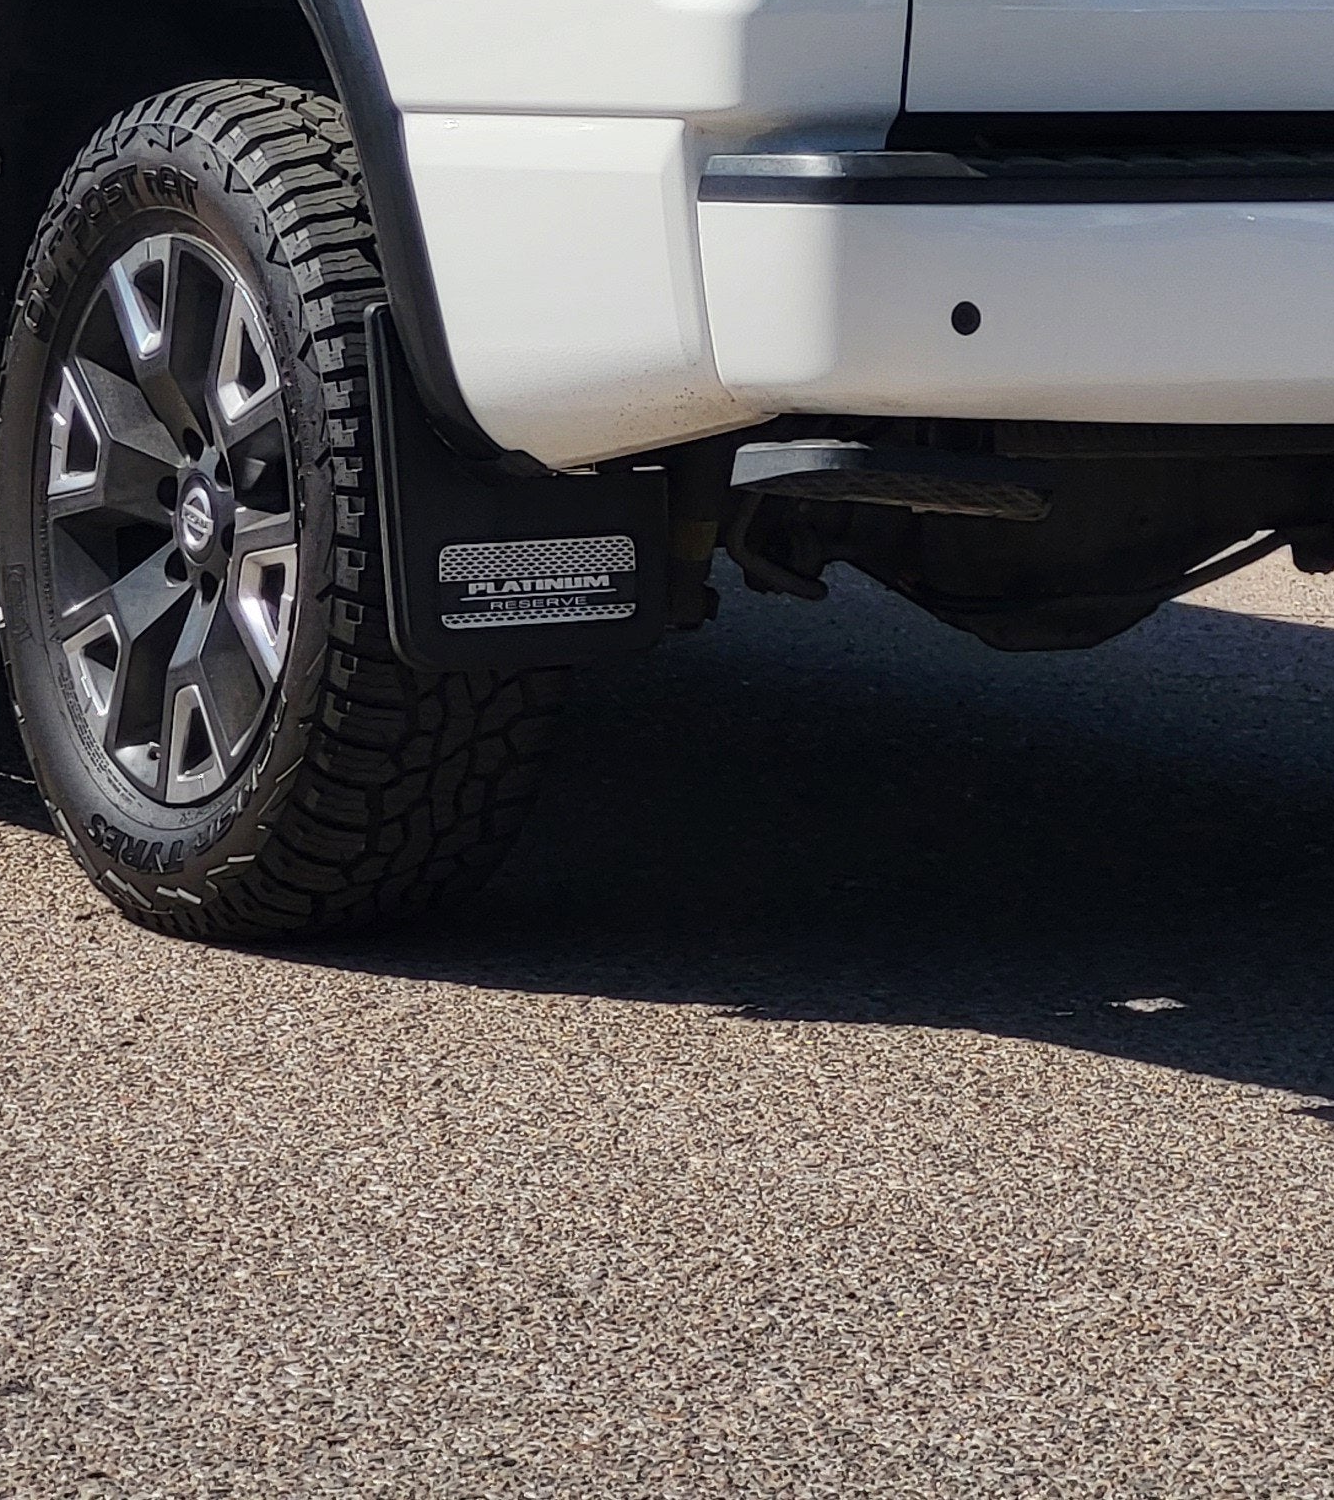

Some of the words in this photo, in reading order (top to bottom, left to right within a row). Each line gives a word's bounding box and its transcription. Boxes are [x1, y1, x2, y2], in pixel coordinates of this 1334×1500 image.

[468, 575, 610, 595] PLATINUM
[490, 596, 588, 611] RESERVE
[86, 813, 185, 875] TYRES
